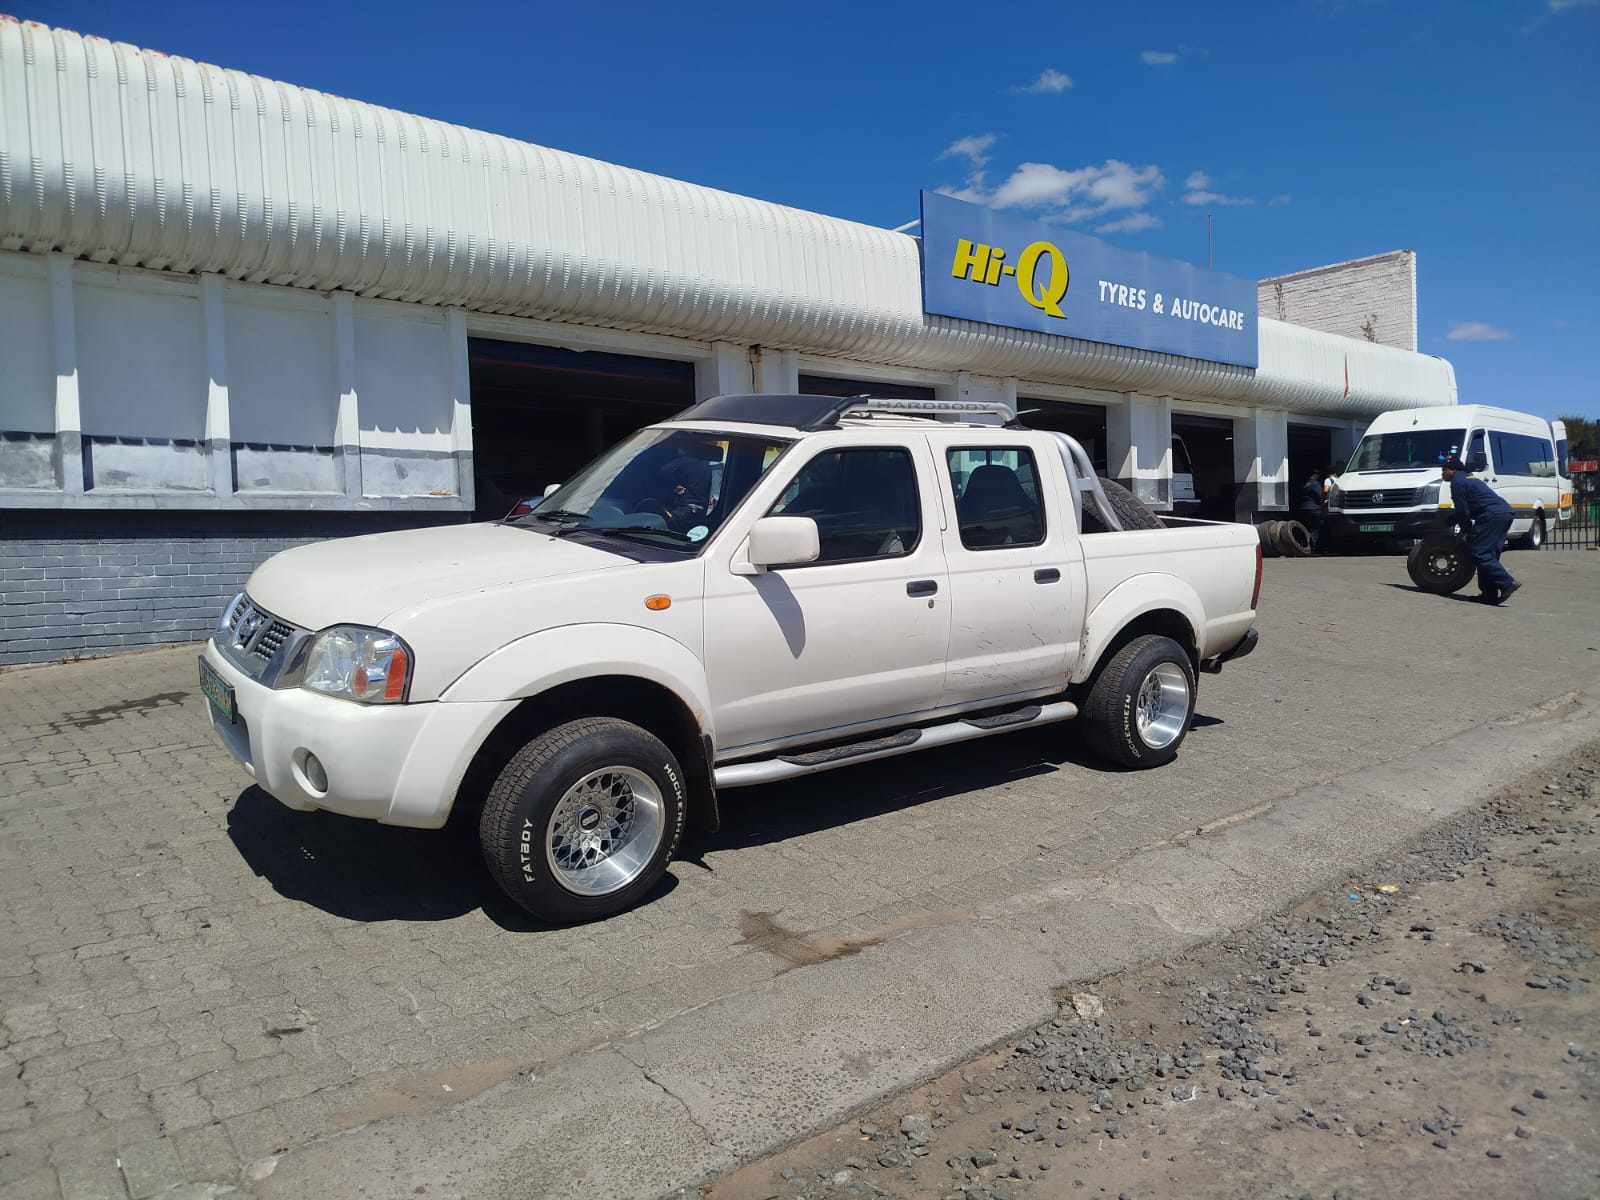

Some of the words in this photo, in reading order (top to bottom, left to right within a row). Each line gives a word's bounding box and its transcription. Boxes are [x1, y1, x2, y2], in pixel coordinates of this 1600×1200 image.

[951, 238, 1069, 319] Hi-Q
[1098, 280, 1146, 311] TYRES
[1152, 293, 1164, 314] &
[1170, 297, 1244, 331] AUTOCARE
[877, 401, 991, 411] HARDBODY
[520, 817, 536, 882] FATBOY
